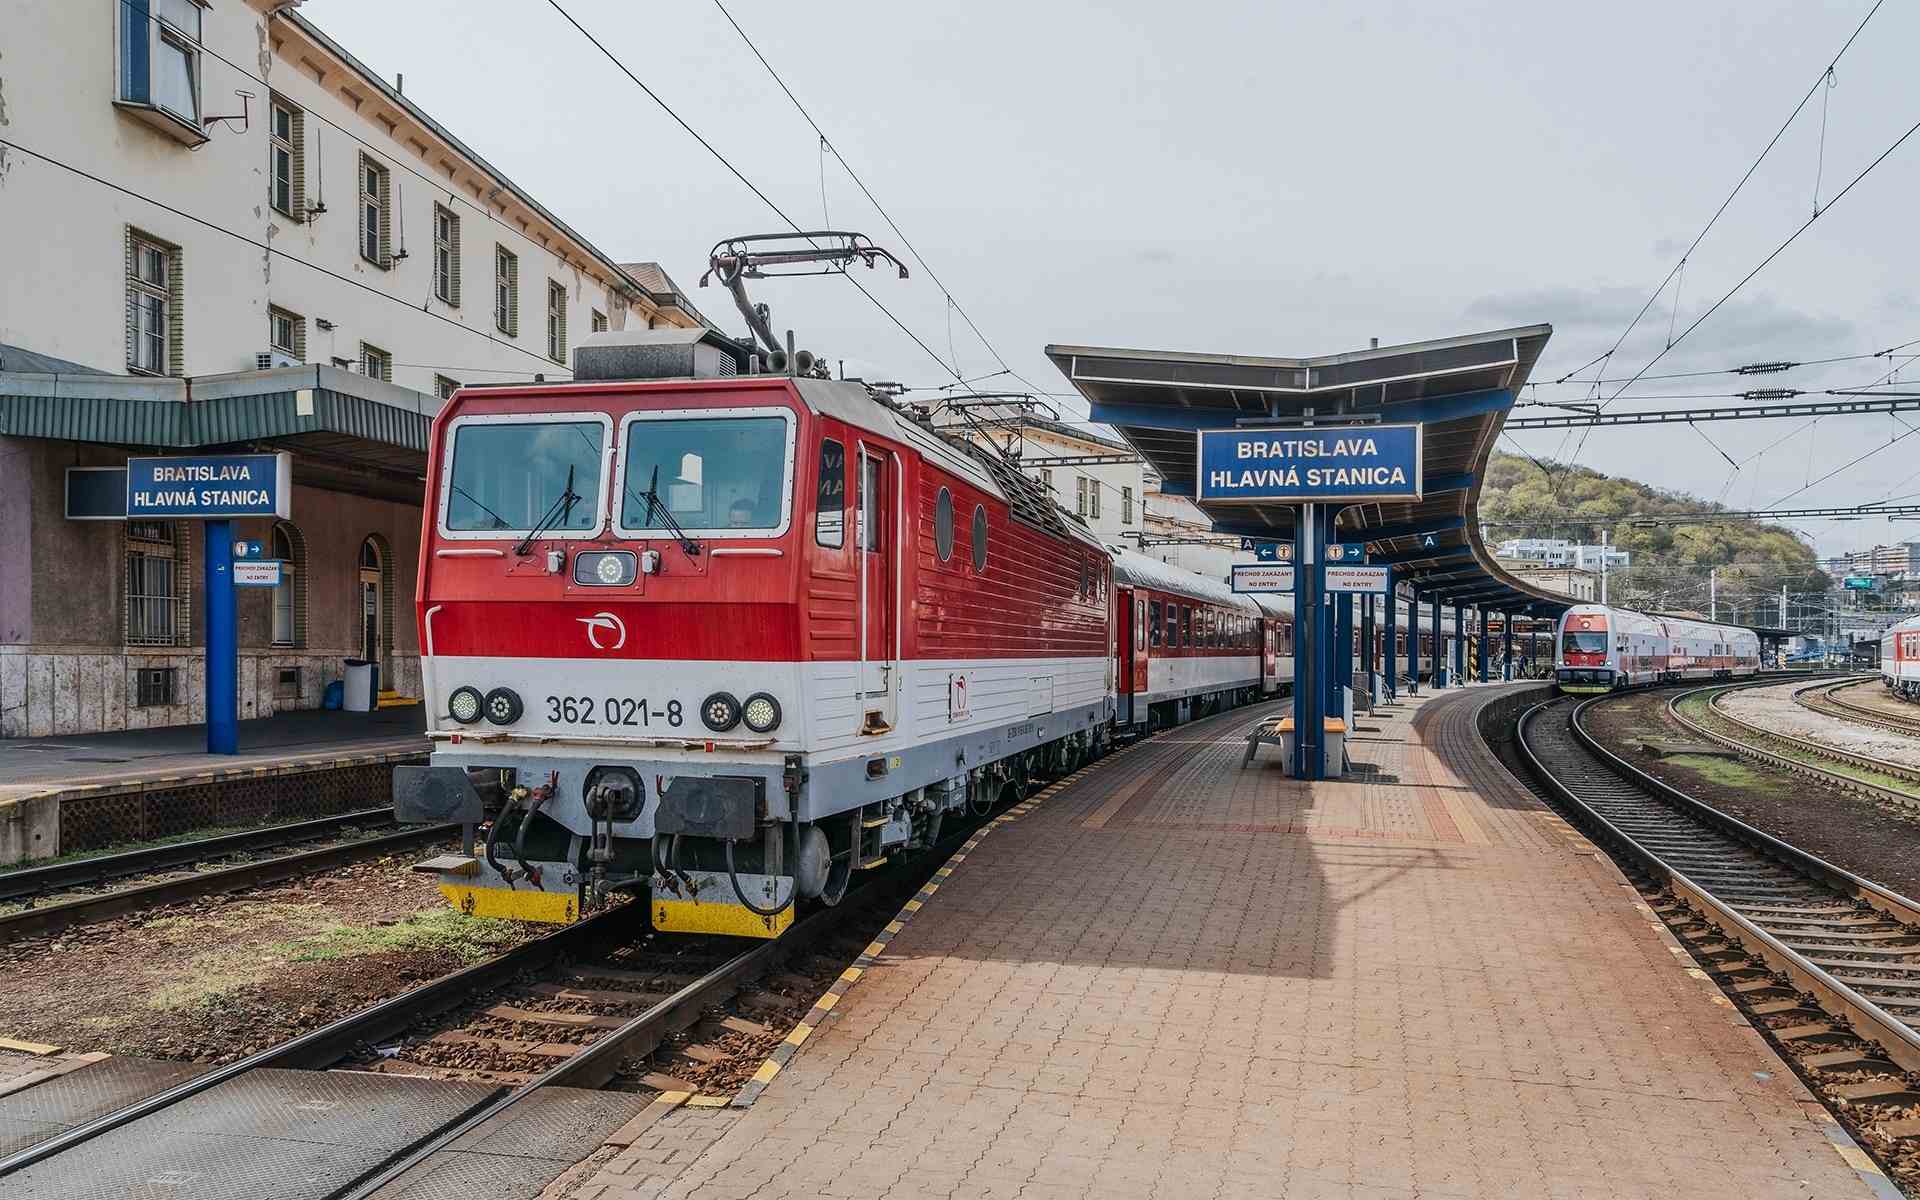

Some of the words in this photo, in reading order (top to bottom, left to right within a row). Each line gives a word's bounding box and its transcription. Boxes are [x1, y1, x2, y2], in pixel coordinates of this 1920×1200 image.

[1237, 438, 1378, 459] BRATISLAVA
[153, 465, 251, 482] BRATISLAVA
[1210, 465, 1300, 488] HLAVNÁ
[1306, 467, 1407, 487] STANICA
[134, 487, 197, 507] HLAVNÁ
[201, 490, 270, 506] STANICA
[1243, 539, 1253, 549] A
[1425, 535, 1435, 547] A
